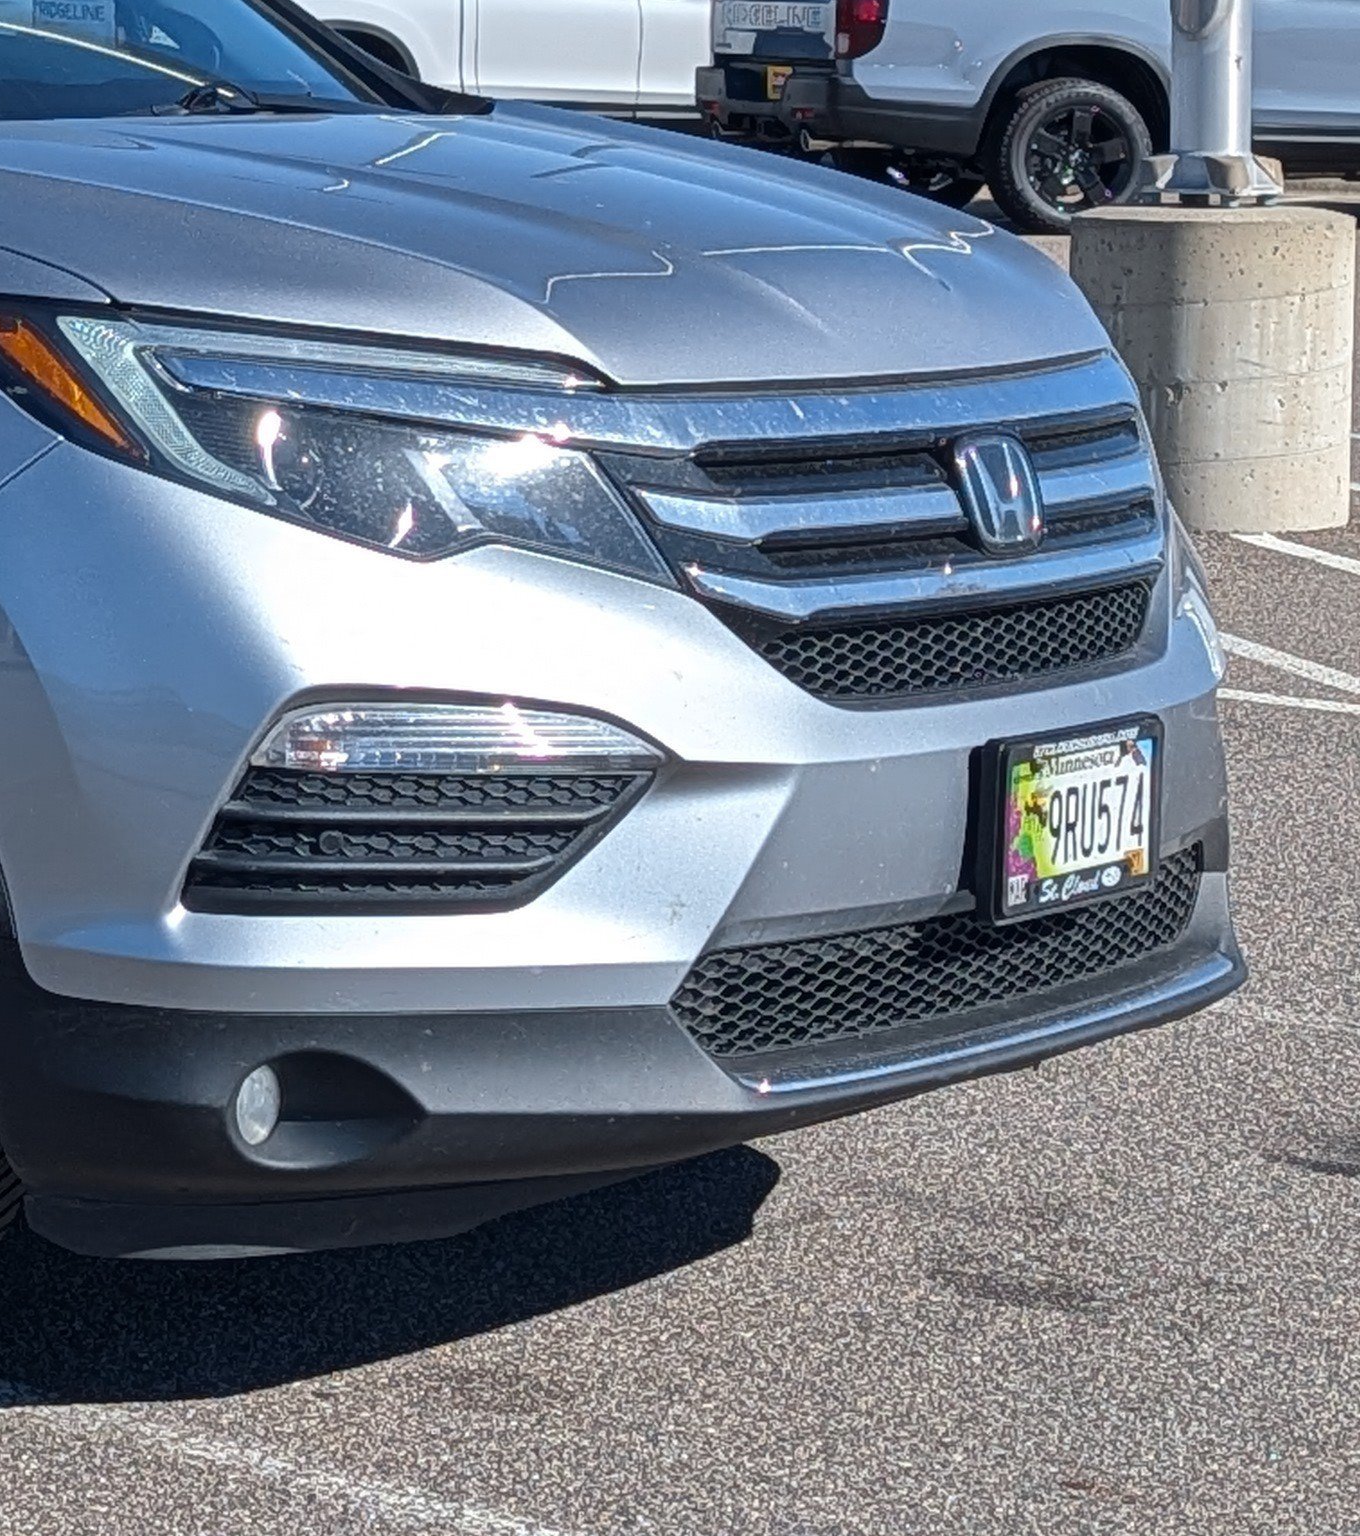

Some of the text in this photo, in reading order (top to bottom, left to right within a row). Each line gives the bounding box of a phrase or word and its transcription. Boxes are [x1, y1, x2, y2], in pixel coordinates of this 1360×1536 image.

[722, 2, 822, 28] RIDGELINE
[1049, 773, 1144, 865] 9RU574
[1038, 878, 1060, 904] St.
[1061, 870, 1100, 901] Cloud
